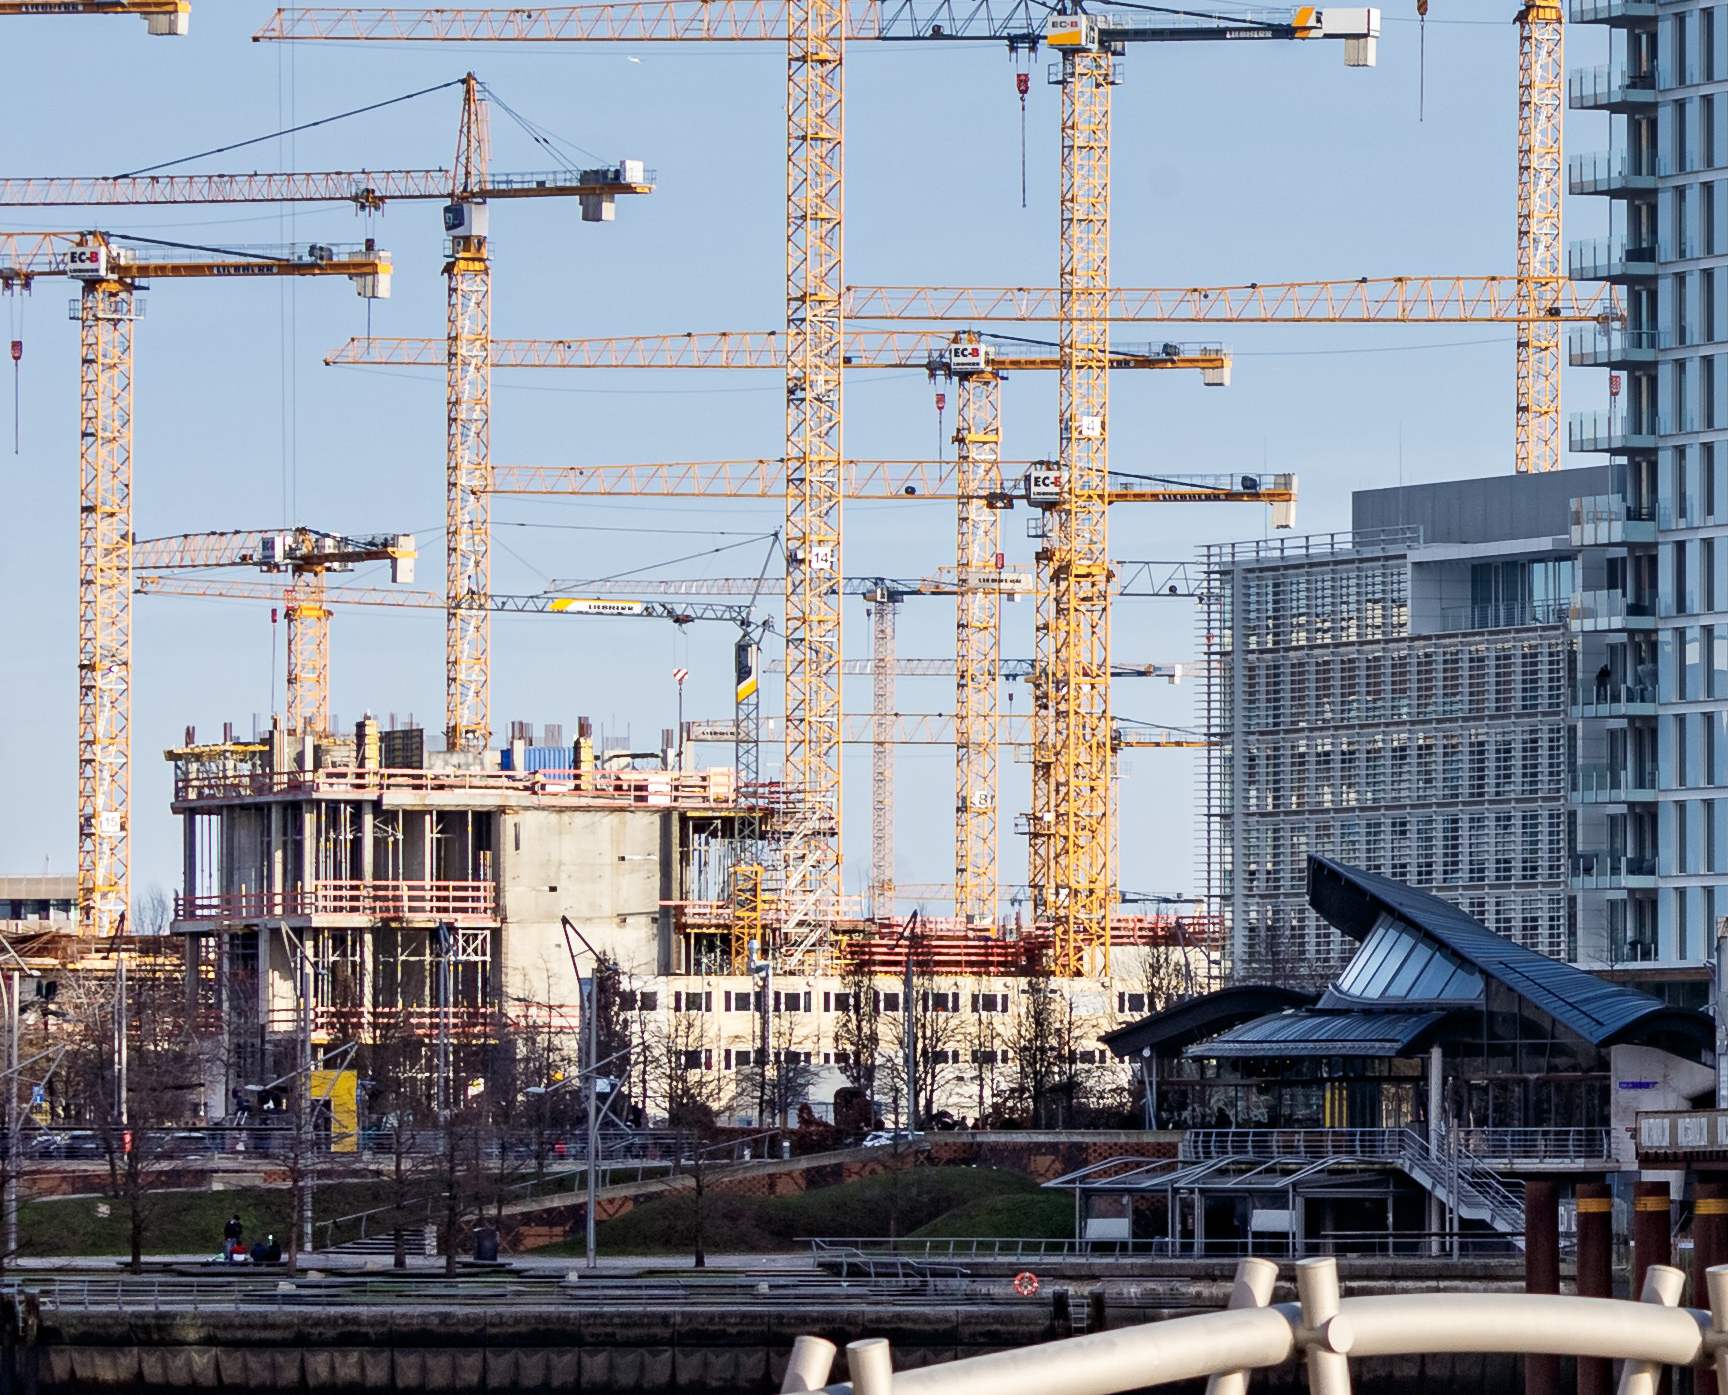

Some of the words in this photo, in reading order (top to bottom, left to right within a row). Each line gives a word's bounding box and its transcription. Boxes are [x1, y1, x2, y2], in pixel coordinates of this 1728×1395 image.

[70, 251, 98, 264] EC-B
[954, 348, 980, 358] EC-B
[814, 553, 828, 563] 14
